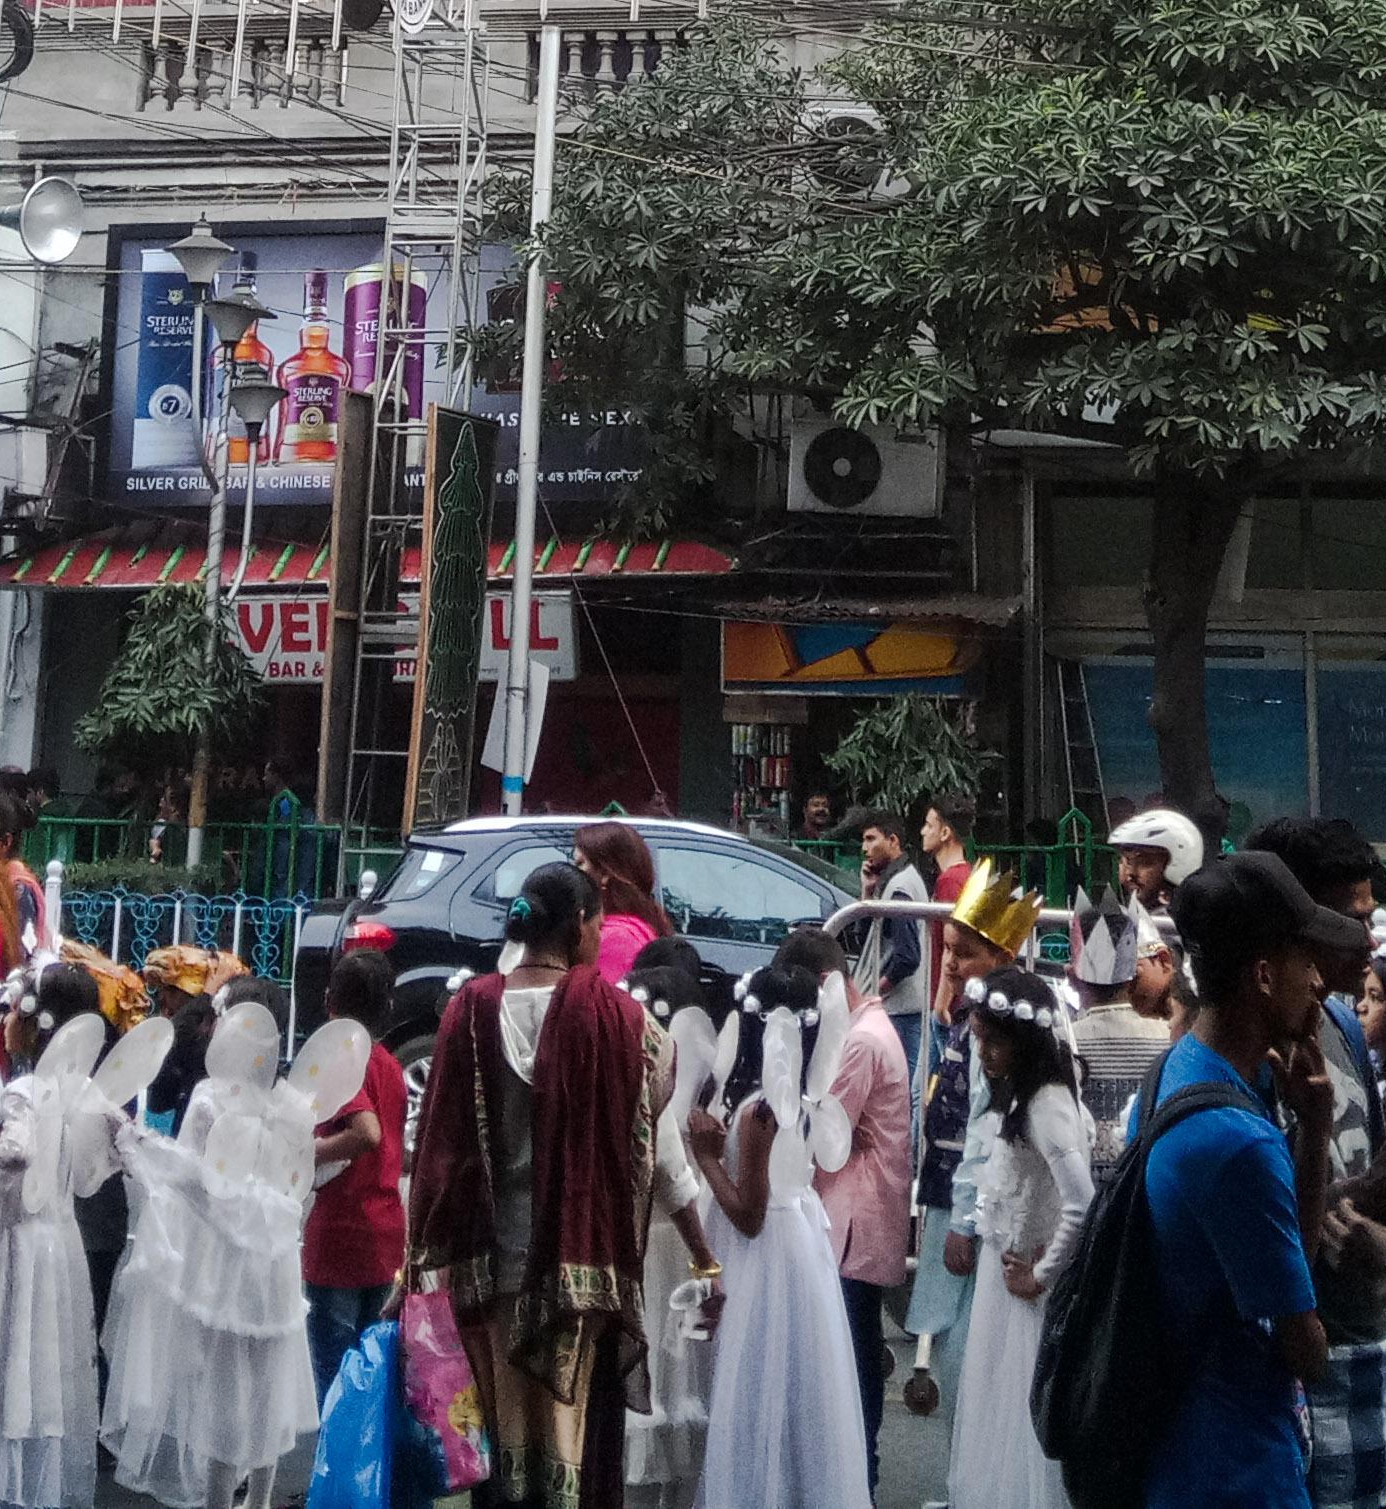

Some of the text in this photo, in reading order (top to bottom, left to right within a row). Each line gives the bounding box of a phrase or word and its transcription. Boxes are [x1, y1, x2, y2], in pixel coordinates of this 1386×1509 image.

[293, 387, 333, 397] STERLING
[126, 477, 174, 490] SILVER
[178, 476, 211, 490] GRIL
[256, 476, 265, 489] &
[270, 475, 331, 489] CHINESE
[268, 661, 324, 678] BAR &
